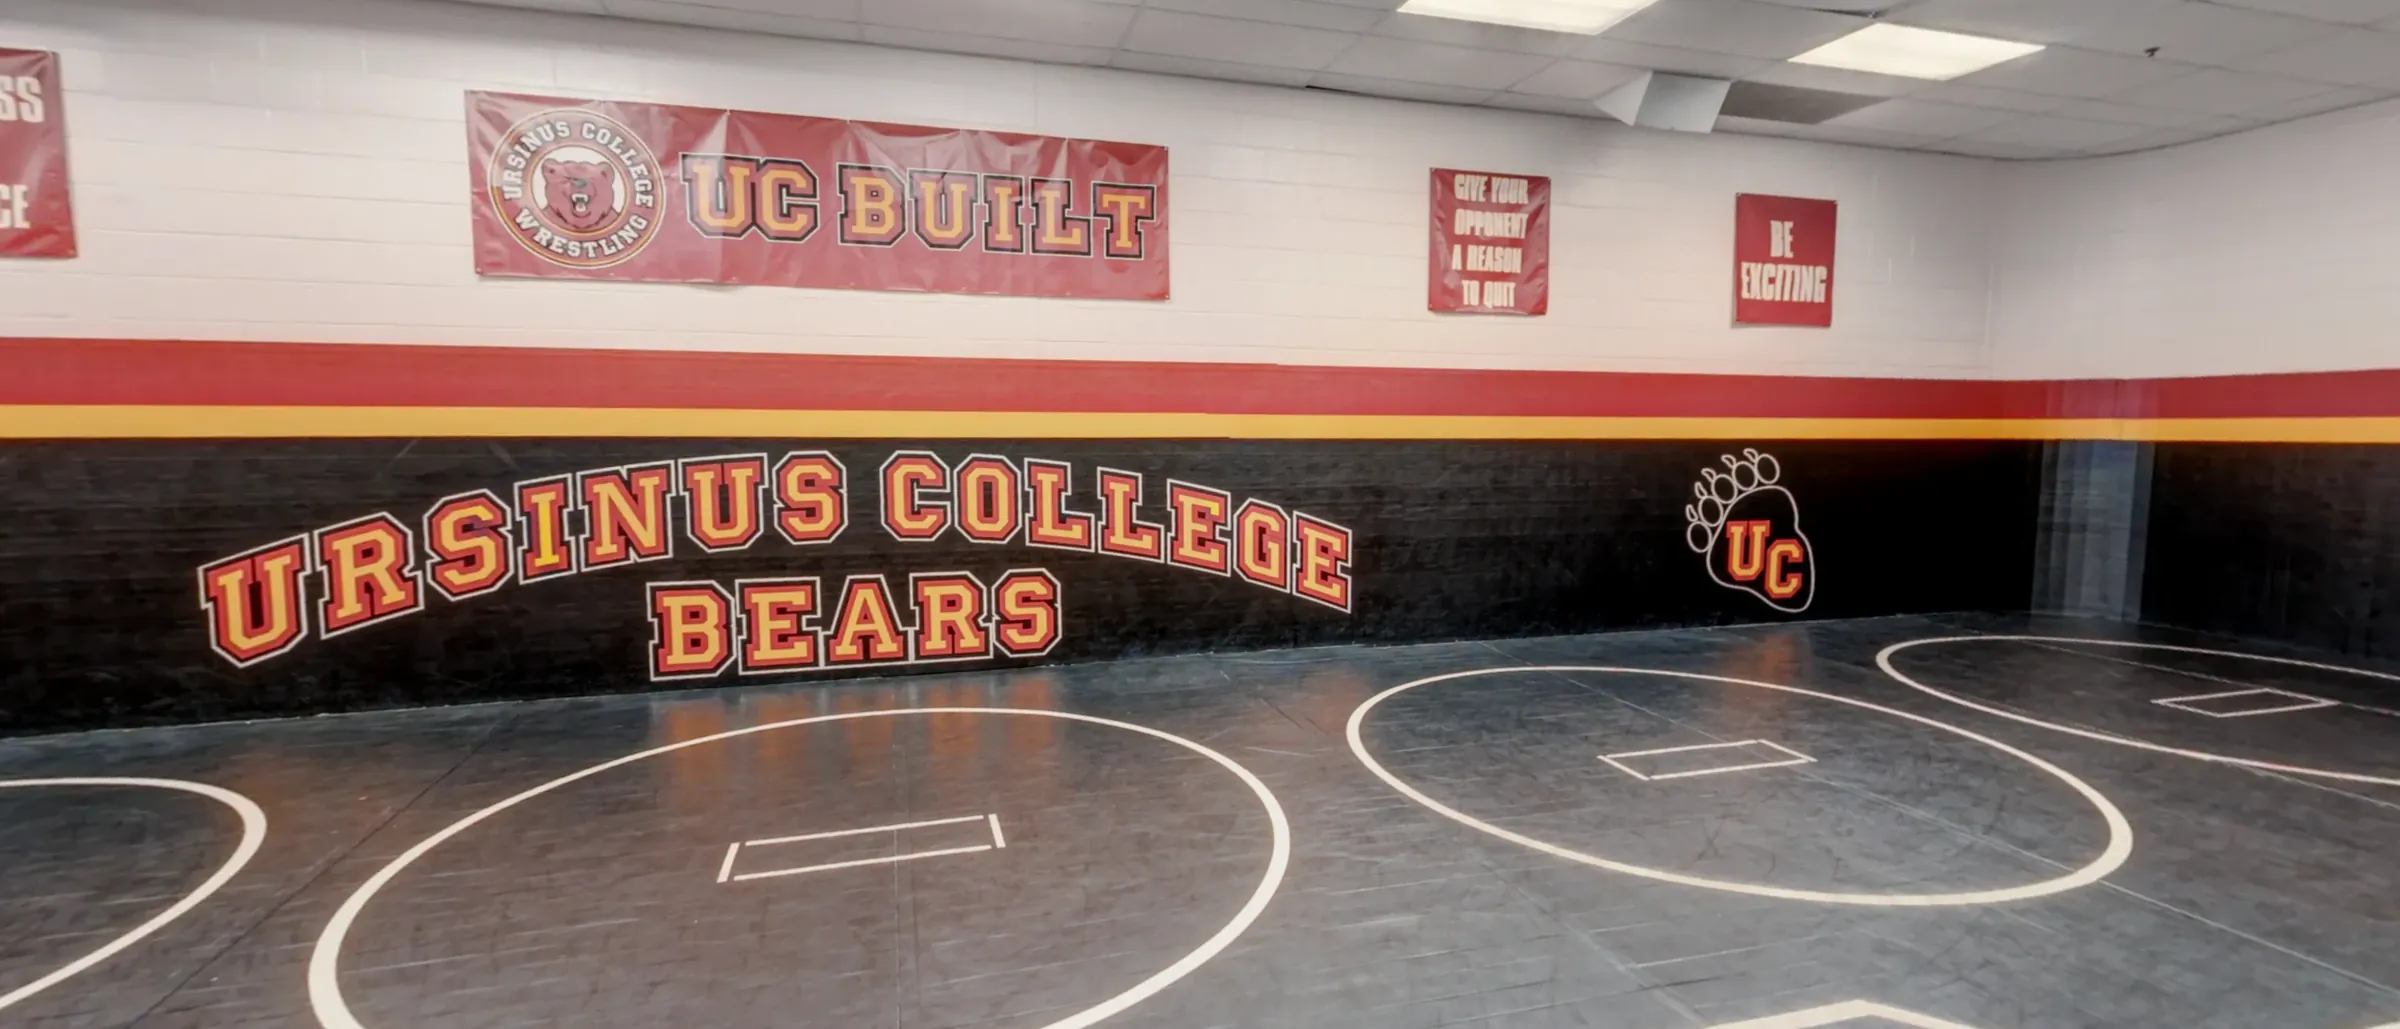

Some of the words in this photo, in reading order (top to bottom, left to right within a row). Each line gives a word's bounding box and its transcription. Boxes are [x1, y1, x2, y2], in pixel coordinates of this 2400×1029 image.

[503, 121, 570, 201] URSINUS
[582, 122, 655, 209] COLLEGE
[680, 152, 819, 243] UC
[836, 162, 1156, 260] BUILT
[1454, 174, 1488, 202] GIVE
[1491, 176, 1529, 204] YOUR
[515, 208, 648, 258] WRESTLING
[1454, 208, 1529, 239] OPPONENT
[1770, 220, 1794, 258] BE
[1452, 244, 1462, 271] A
[1467, 244, 1522, 274] REASON
[1462, 279, 1480, 306] TO
[1483, 281, 1516, 308] QUIT
[1741, 261, 1828, 304] EXCITING
[197, 450, 848, 668] URSINUS
[879, 450, 1352, 614] COLLEGE
[1726, 519, 1804, 600] UC
[646, 567, 1062, 682] BEARS
